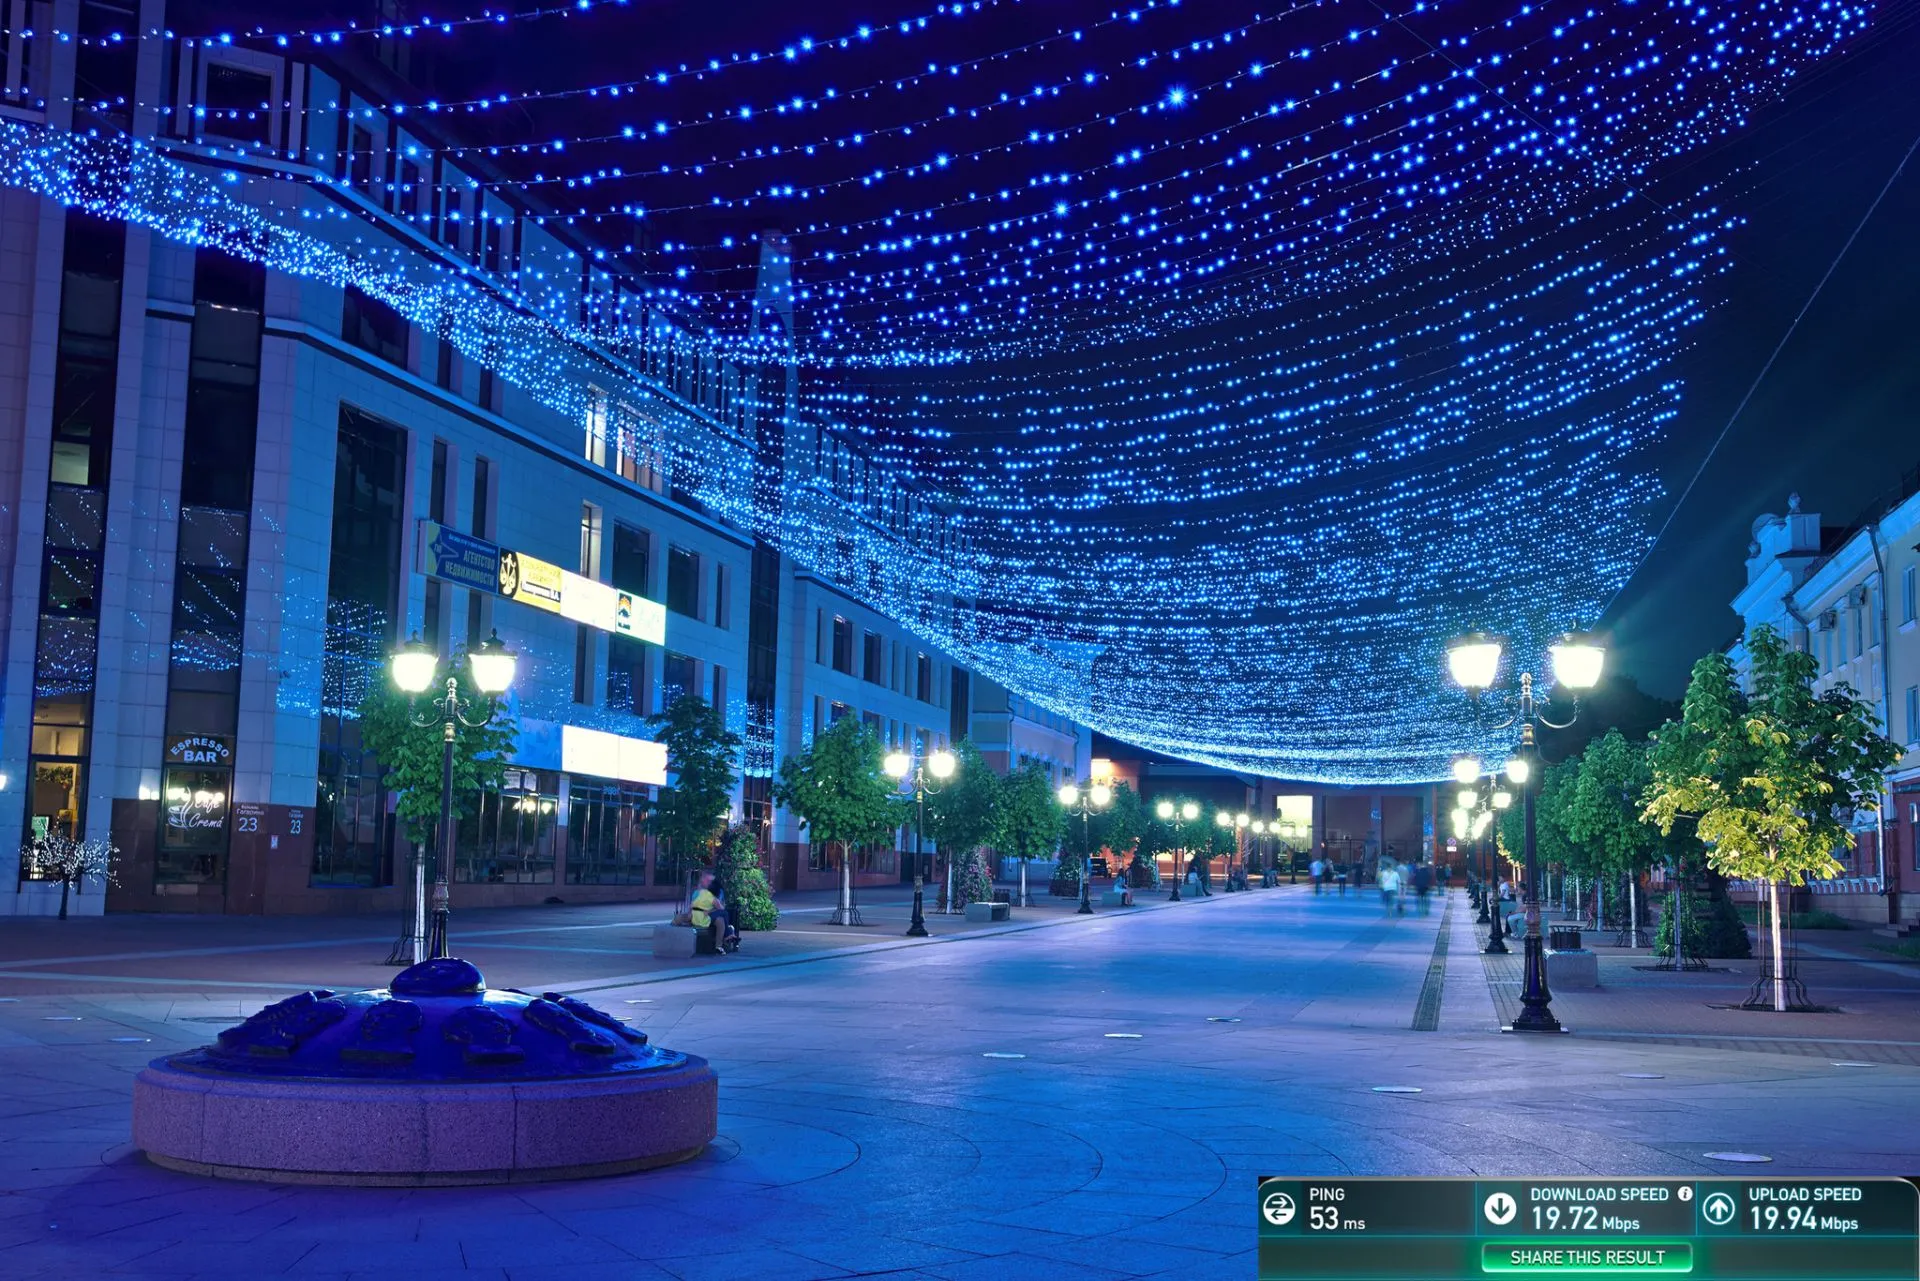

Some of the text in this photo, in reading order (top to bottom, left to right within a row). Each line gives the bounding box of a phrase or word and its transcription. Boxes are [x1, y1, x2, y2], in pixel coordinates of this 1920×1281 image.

[463, 550, 495, 571] АГЕНТСТВО
[445, 560, 495, 588] НЕДВИЖИМОСТИ
[170, 737, 230, 758] ESPRESSO
[183, 750, 217, 763] BAR
[238, 817, 258, 832] 23
[290, 819, 301, 834] 23
